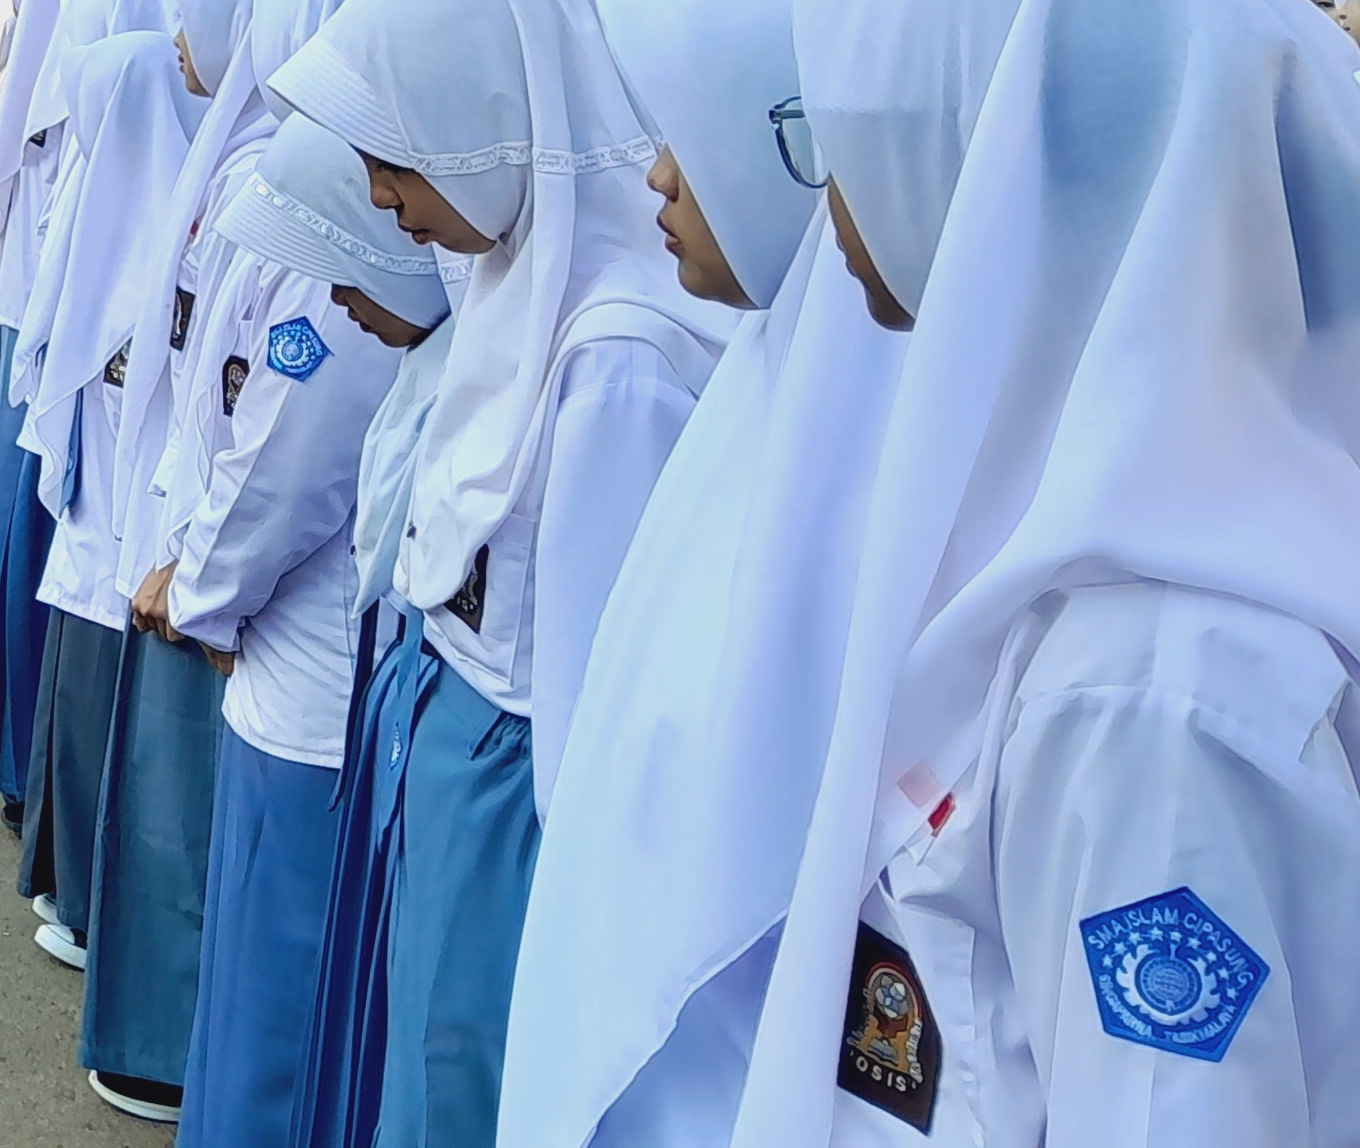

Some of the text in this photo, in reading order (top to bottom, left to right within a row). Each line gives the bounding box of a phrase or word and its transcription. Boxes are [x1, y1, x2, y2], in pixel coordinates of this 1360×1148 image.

[1088, 907, 1254, 989] SMA ISLAM CIPASUNG
[855, 1055, 907, 1093] OSIS
